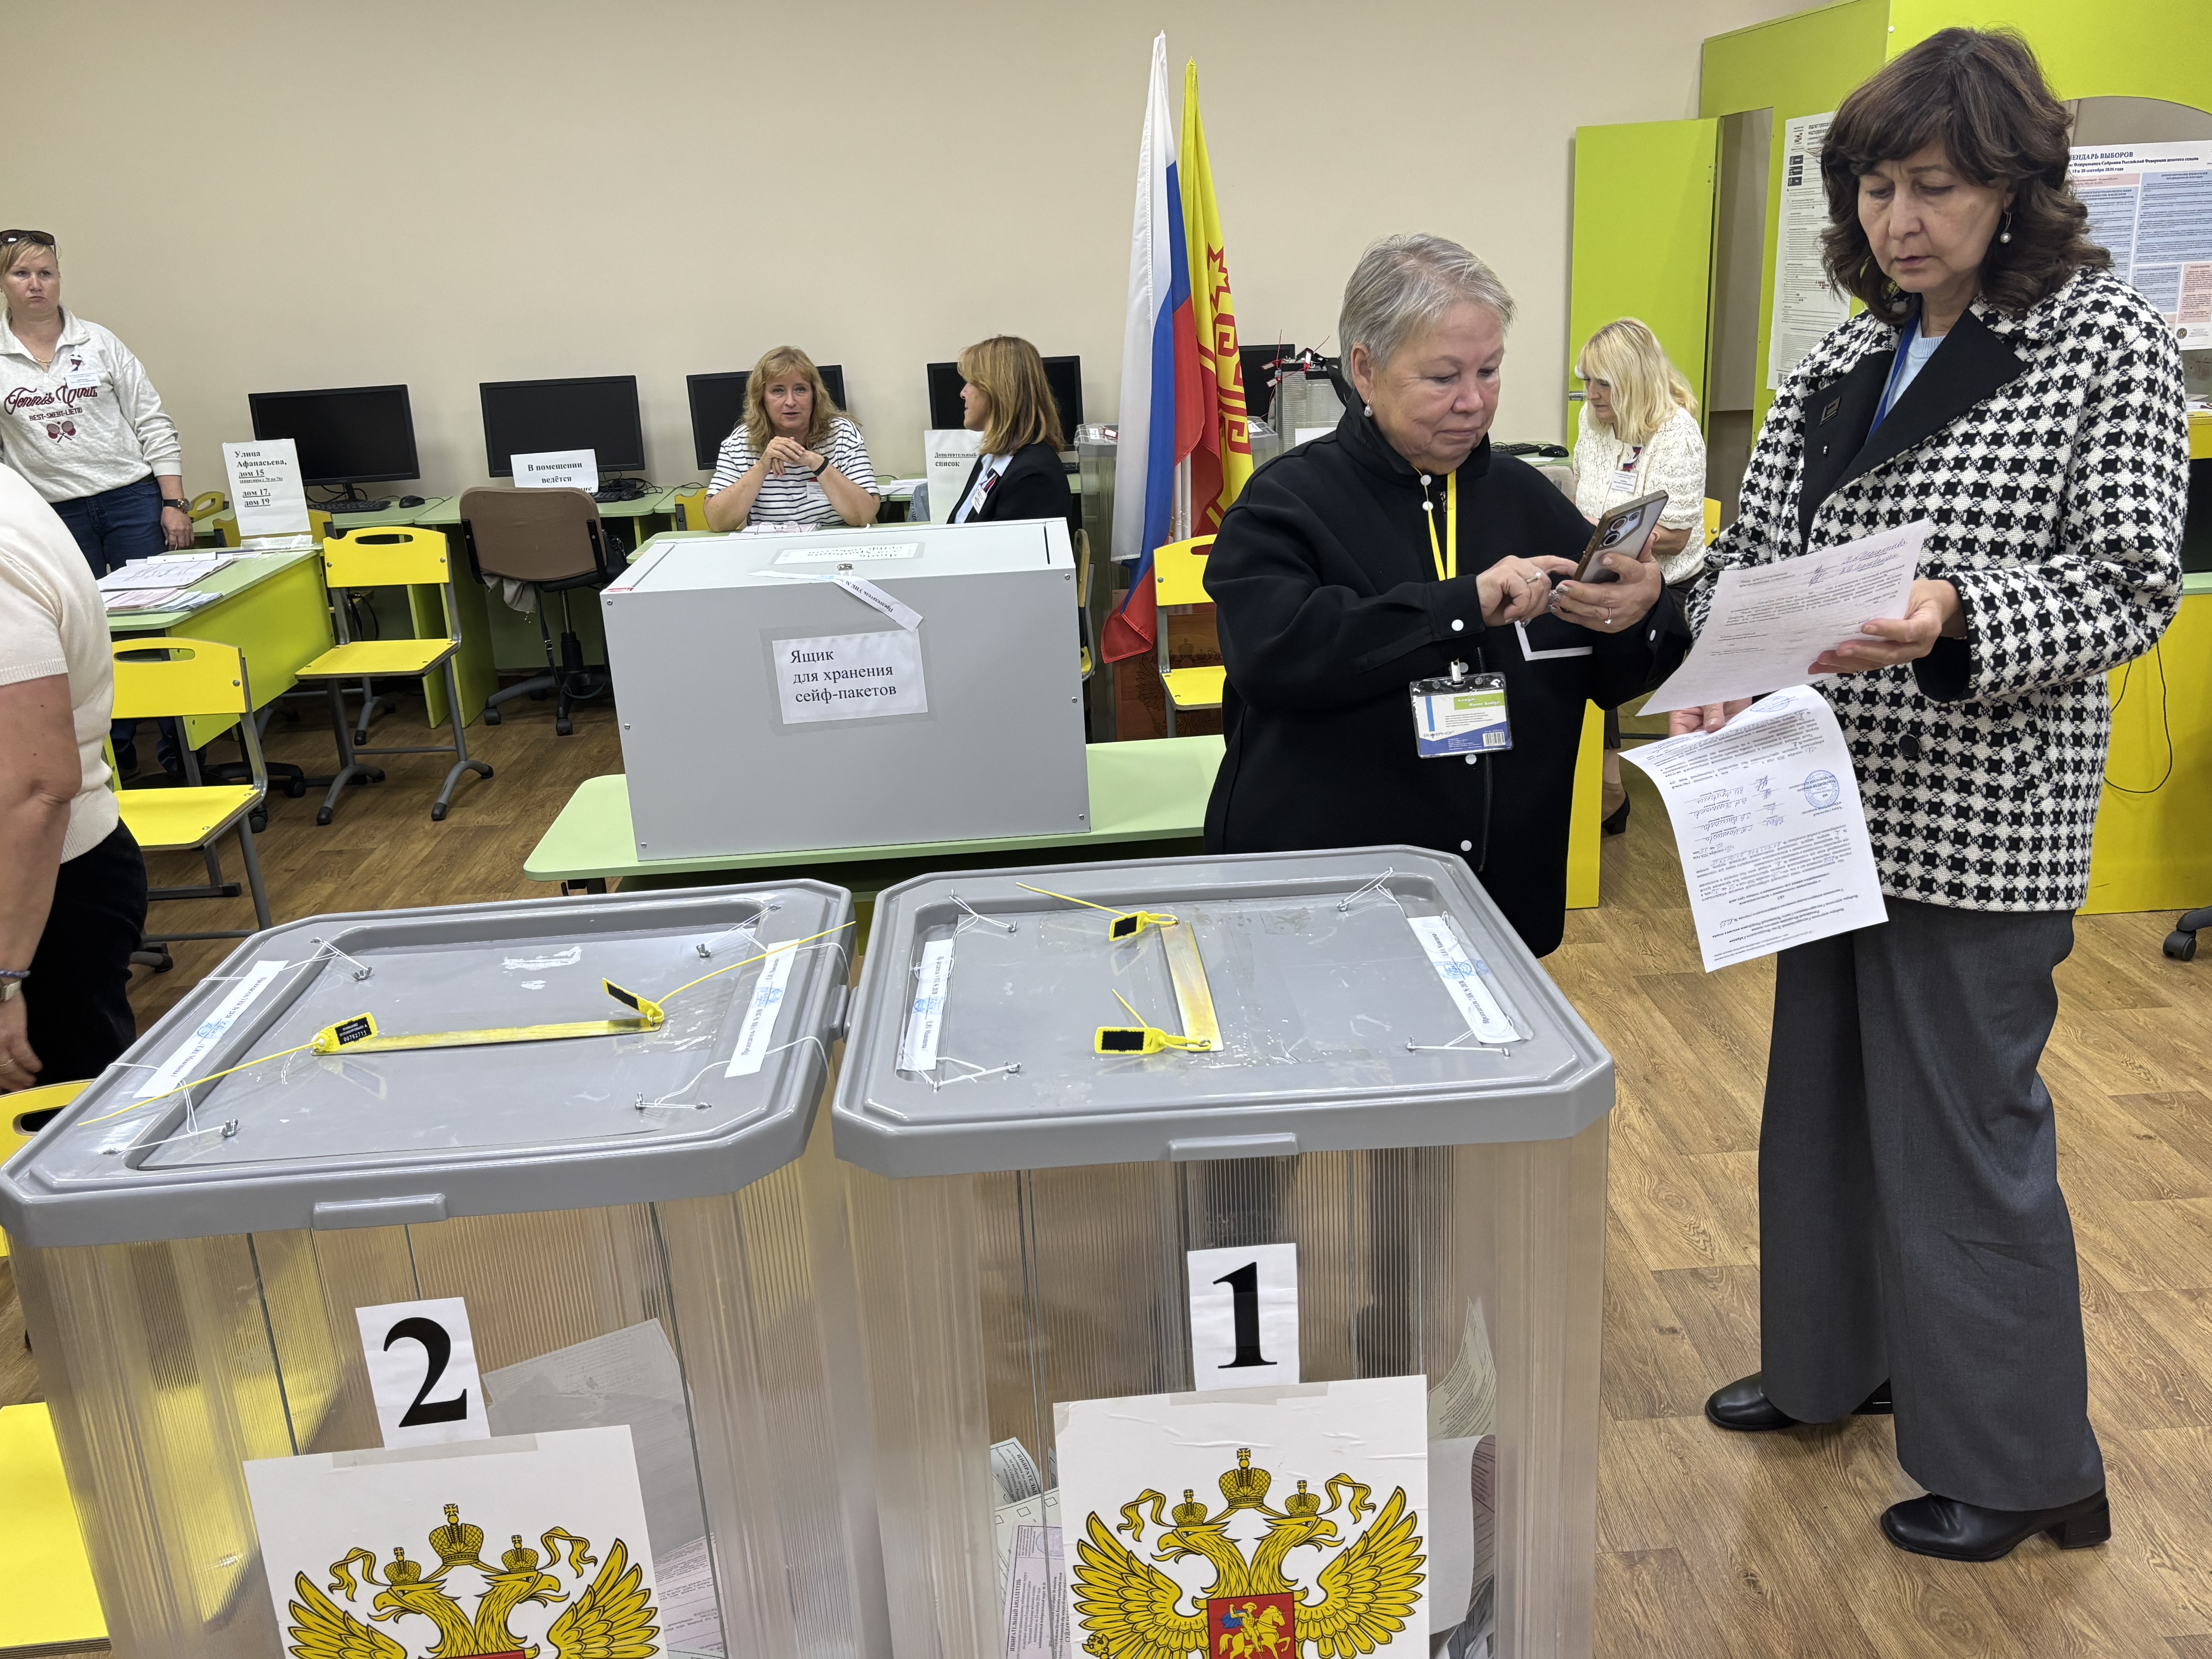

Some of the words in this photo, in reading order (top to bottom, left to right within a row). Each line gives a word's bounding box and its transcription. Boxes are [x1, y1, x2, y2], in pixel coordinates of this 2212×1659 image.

[4, 387, 55, 415] Tennis
[864, 591, 893, 613] Председатель
[790, 650, 835, 664] Ящик
[793, 672, 819, 684] для
[823, 665, 893, 683] хранения
[795, 684, 897, 704] сейф-пакетов
[1213, 1262, 1278, 1369] 1
[383, 1317, 467, 1427] 2
[1010, 1608, 1018, 1651] ИЗБИРАТЕЛЬНЫЙ
